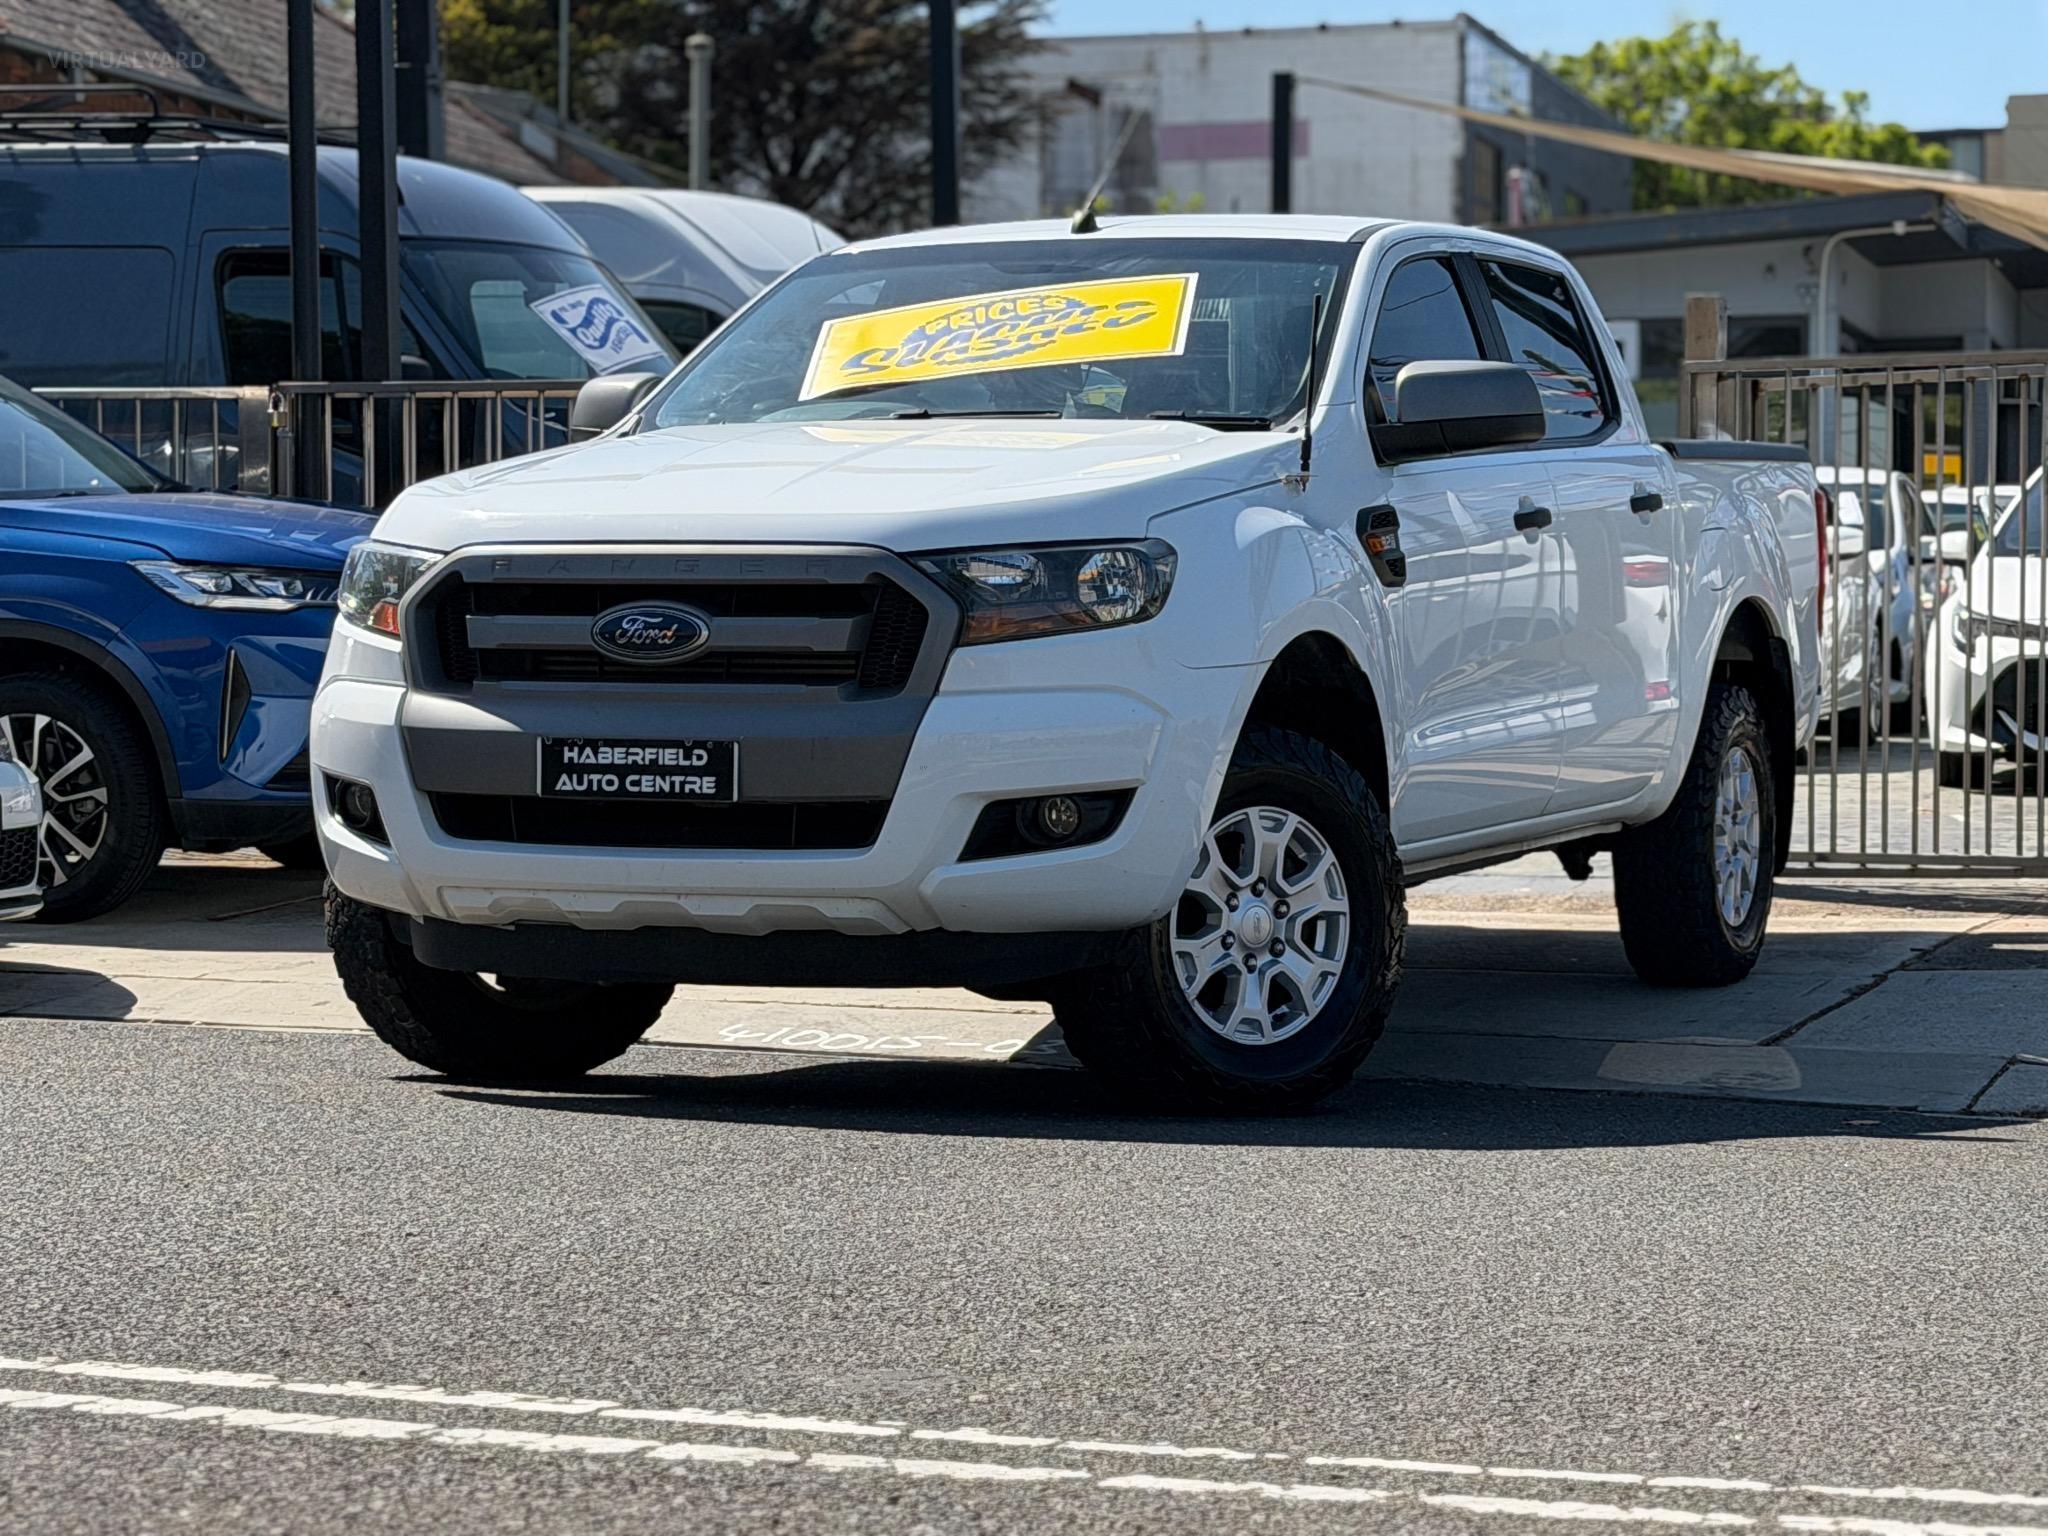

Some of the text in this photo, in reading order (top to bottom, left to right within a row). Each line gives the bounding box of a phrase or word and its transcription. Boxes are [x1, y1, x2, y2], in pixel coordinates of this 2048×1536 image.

[925, 295, 1068, 335] PRICES
[491, 558, 833, 575] RANGER
[615, 615, 679, 644] Ford
[563, 745, 709, 767] HABERFIELD
[555, 773, 717, 794] AUTO CENTRE
